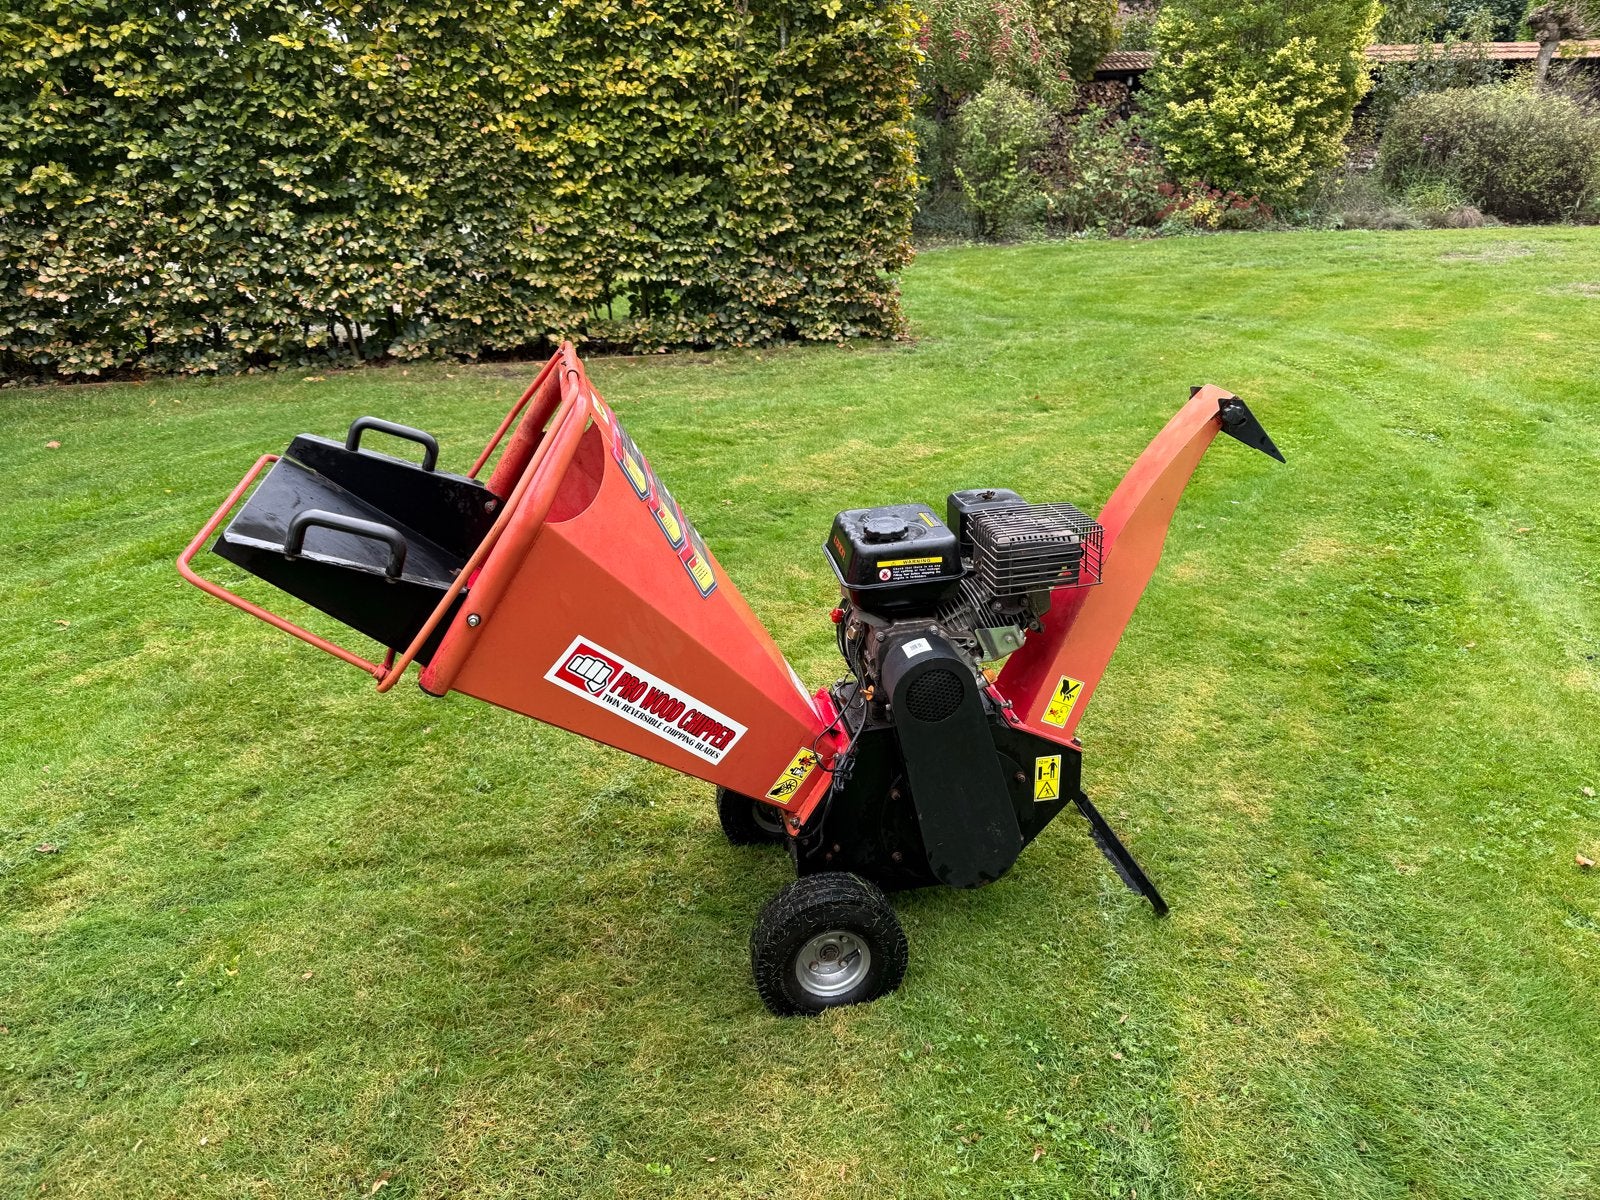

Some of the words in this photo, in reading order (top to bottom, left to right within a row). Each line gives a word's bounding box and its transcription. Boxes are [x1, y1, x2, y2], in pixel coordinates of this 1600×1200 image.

[602, 694, 621, 708] TWIN
[621, 704, 663, 730] REVERSIBLE
[663, 725, 696, 746] CHIPPING
[695, 741, 721, 760] BLADES
[609, 672, 648, 702] PRO
[640, 686, 686, 722] WOOD
[677, 709, 736, 751] CHIPPER
